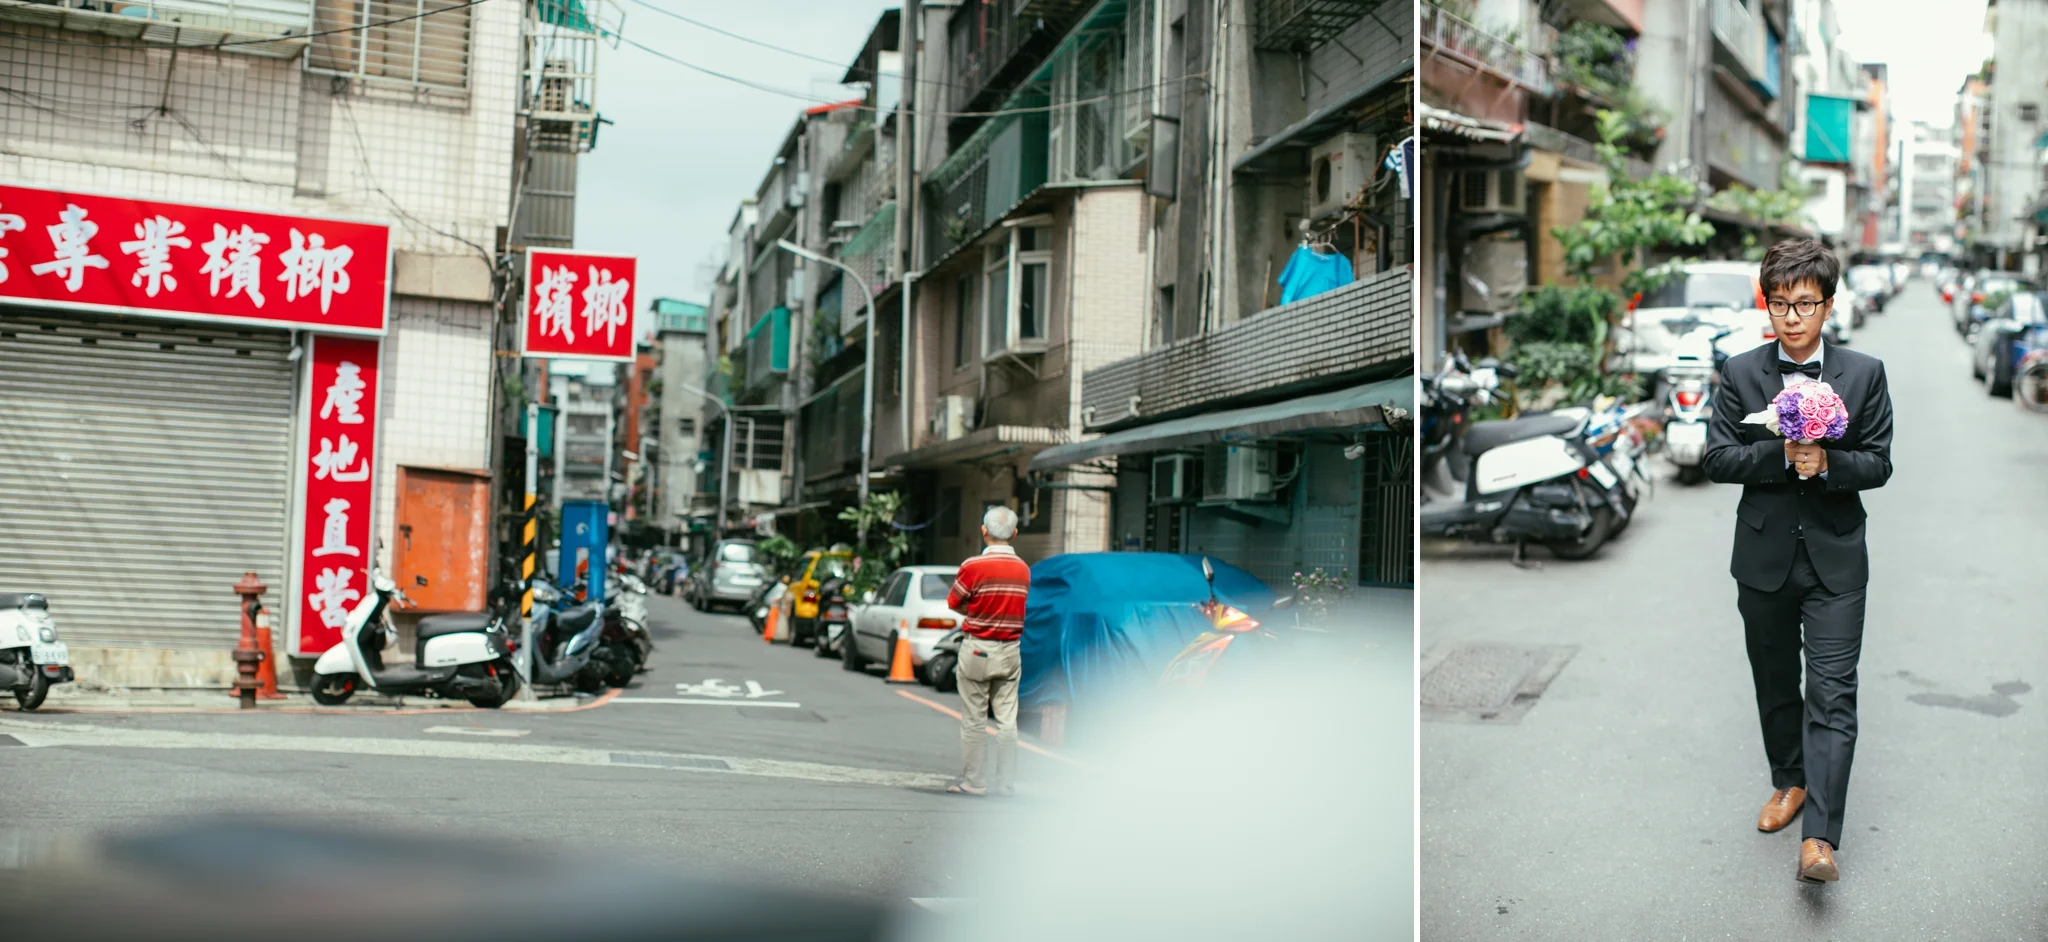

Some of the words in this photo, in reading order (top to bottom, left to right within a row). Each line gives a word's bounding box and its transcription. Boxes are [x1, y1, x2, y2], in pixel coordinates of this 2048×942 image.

[533, 264, 630, 347] 檳榔
[308, 361, 370, 629] 產地直營
